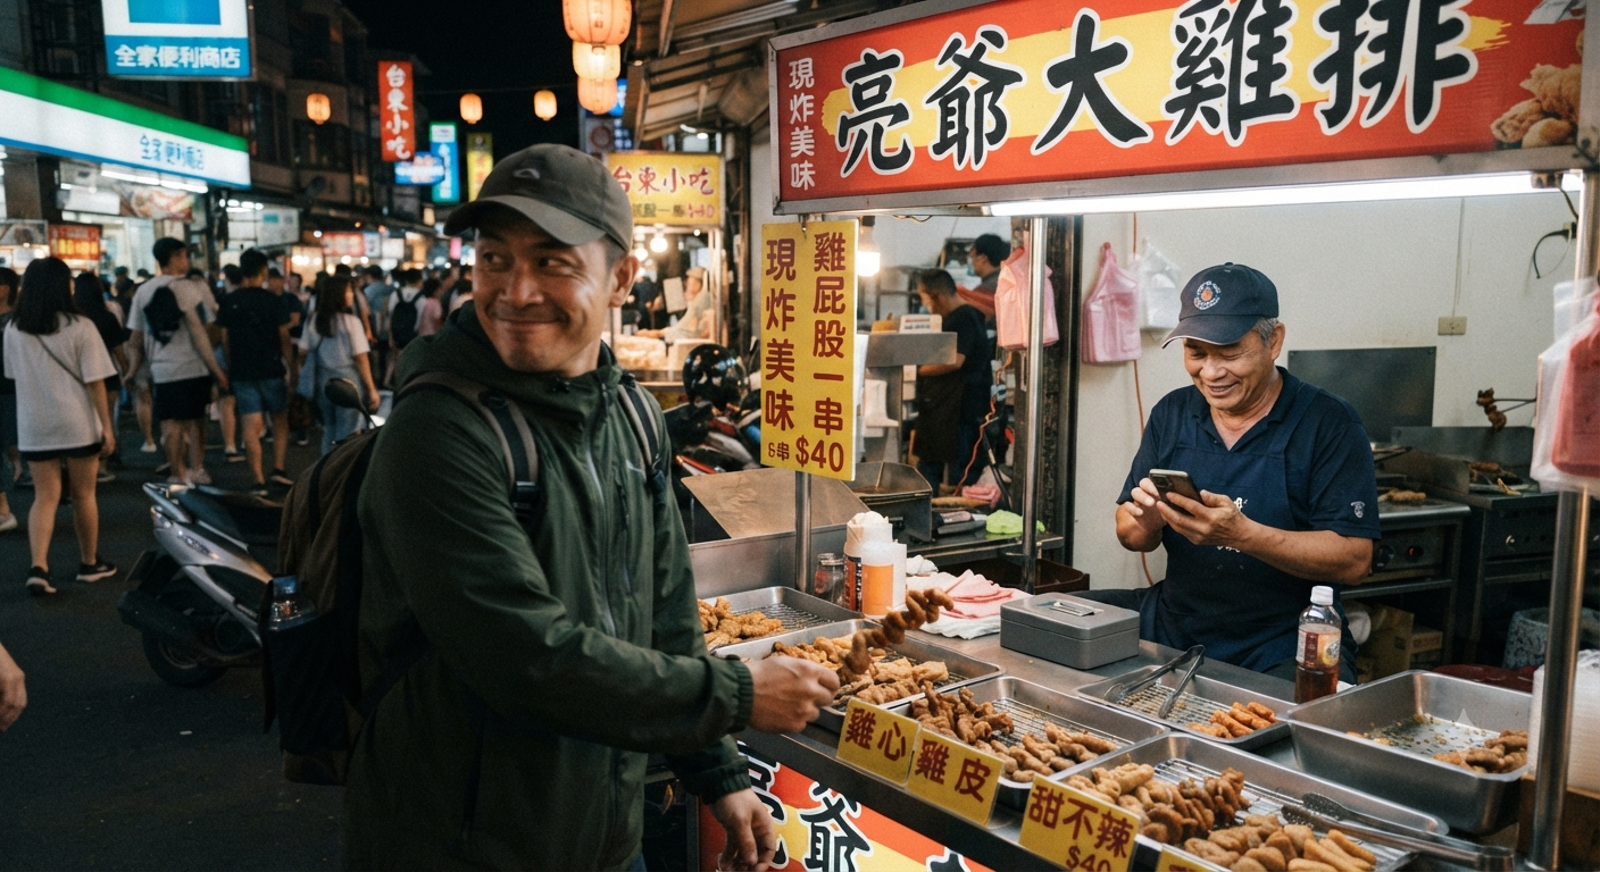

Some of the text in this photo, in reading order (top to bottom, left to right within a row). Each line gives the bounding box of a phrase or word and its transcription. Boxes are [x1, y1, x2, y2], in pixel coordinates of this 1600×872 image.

[114, 44, 241, 69] 全家便利商店
[836, 0, 1476, 177] 亮爺大雞排
[788, 57, 815, 190] 現炸美味
[765, 238, 797, 432] 現炸美味
[813, 231, 847, 436] 雞屁股一串
[795, 434, 845, 473] $40
[844, 707, 907, 762] 雞心
[914, 738, 992, 804] 雞皮
[1028, 784, 1135, 859] 甜不辣
